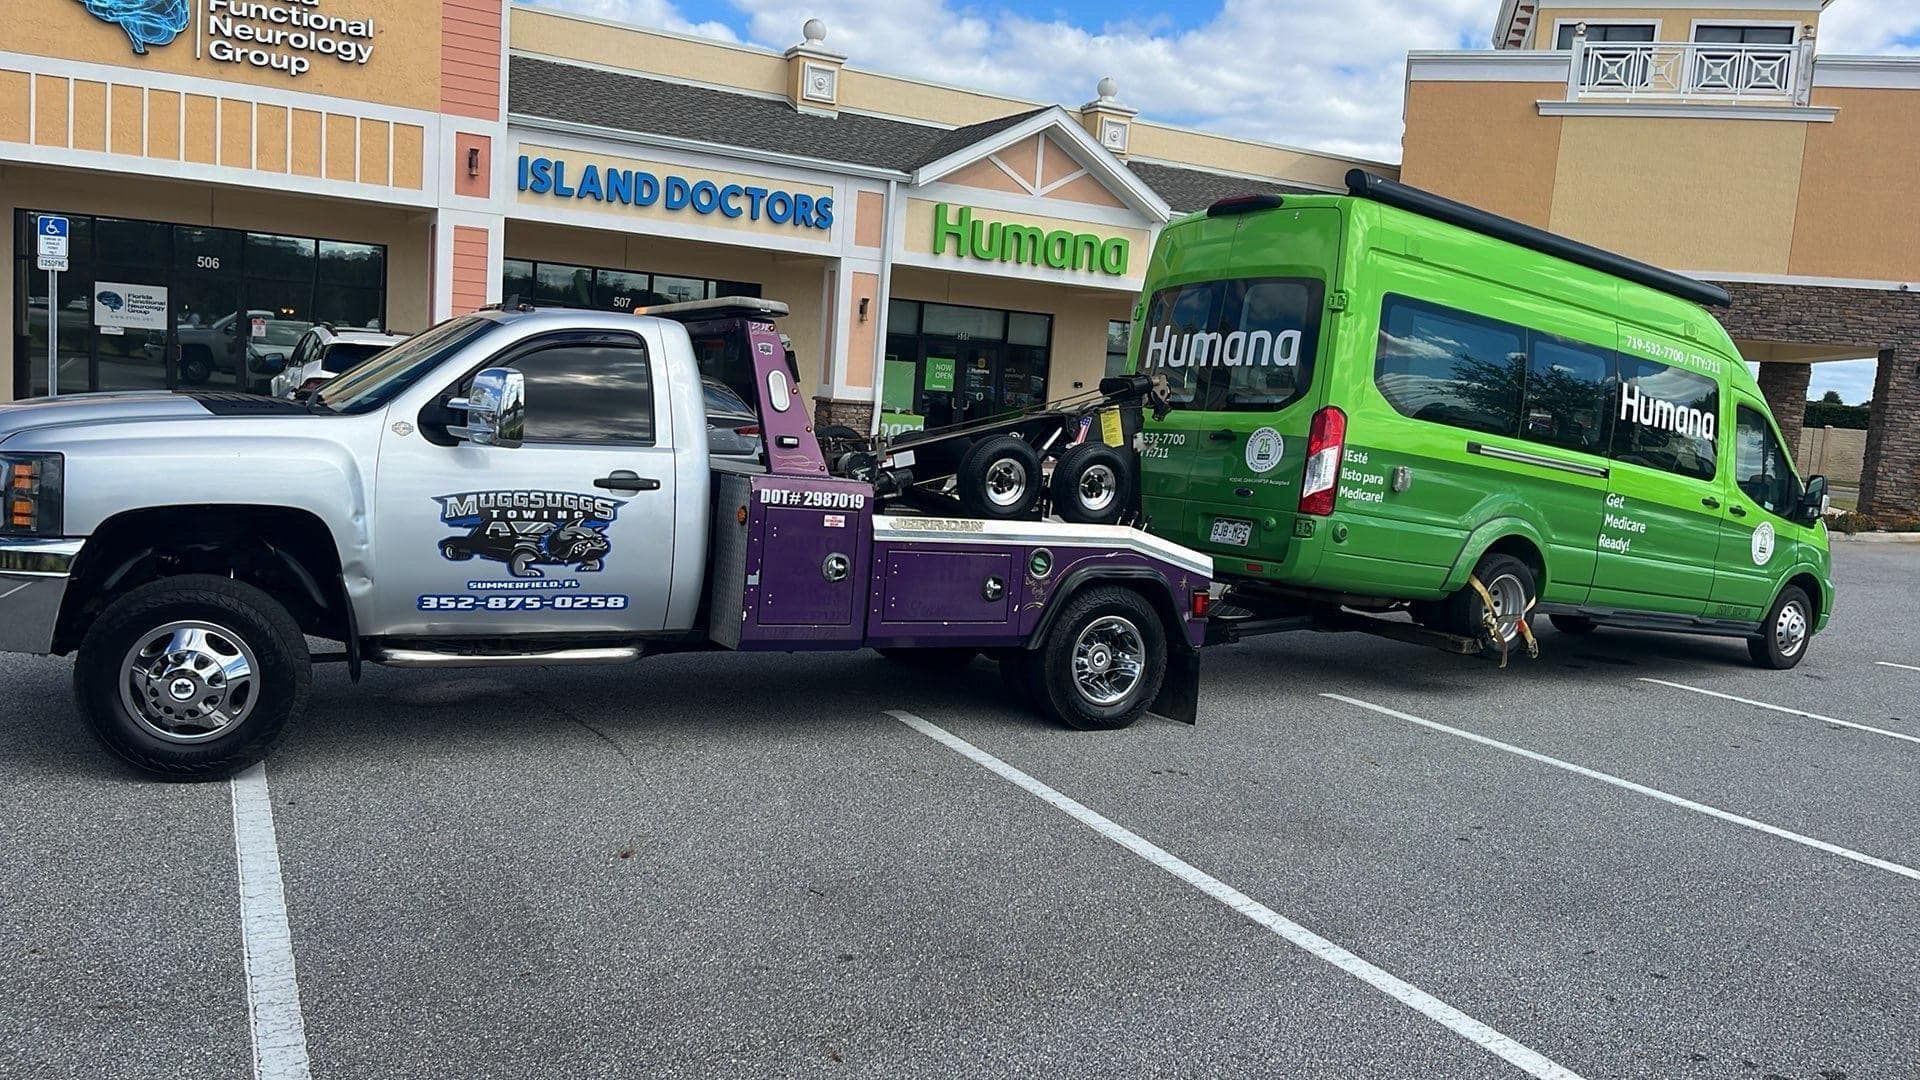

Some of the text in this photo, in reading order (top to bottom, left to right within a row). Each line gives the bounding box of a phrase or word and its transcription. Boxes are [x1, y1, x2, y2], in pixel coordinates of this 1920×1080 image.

[209, 0, 374, 38] Functional
[209, 15, 374, 64] Neurology
[209, 40, 311, 76] Group
[518, 155, 834, 230] ISLAND DOCTORS
[933, 202, 1130, 276] Humana
[197, 255, 221, 270] 506
[613, 295, 631, 309] 507
[1144, 325, 1302, 369] Humana
[1626, 335, 1684, 362] 719-532-7700
[935, 363, 953, 371] NOW
[935, 371, 953, 380] OPEN
[1620, 383, 1715, 441] Humana
[1143, 432, 1185, 445] 532-7700
[1258, 437, 1271, 454] 25
[1341, 467, 1384, 486] listo para
[760, 489, 865, 509] DOT# 2987019
[1338, 485, 1384, 503] Medicare!
[1606, 493, 1625, 509] Get
[446, 491, 615, 520] MUGGSUGGS
[1604, 513, 1647, 533] Medicare
[1598, 533, 1632, 554] Ready!
[468, 580, 579, 590] SUMMERFIELD, FL
[421, 597, 625, 609] 352-875-0258
